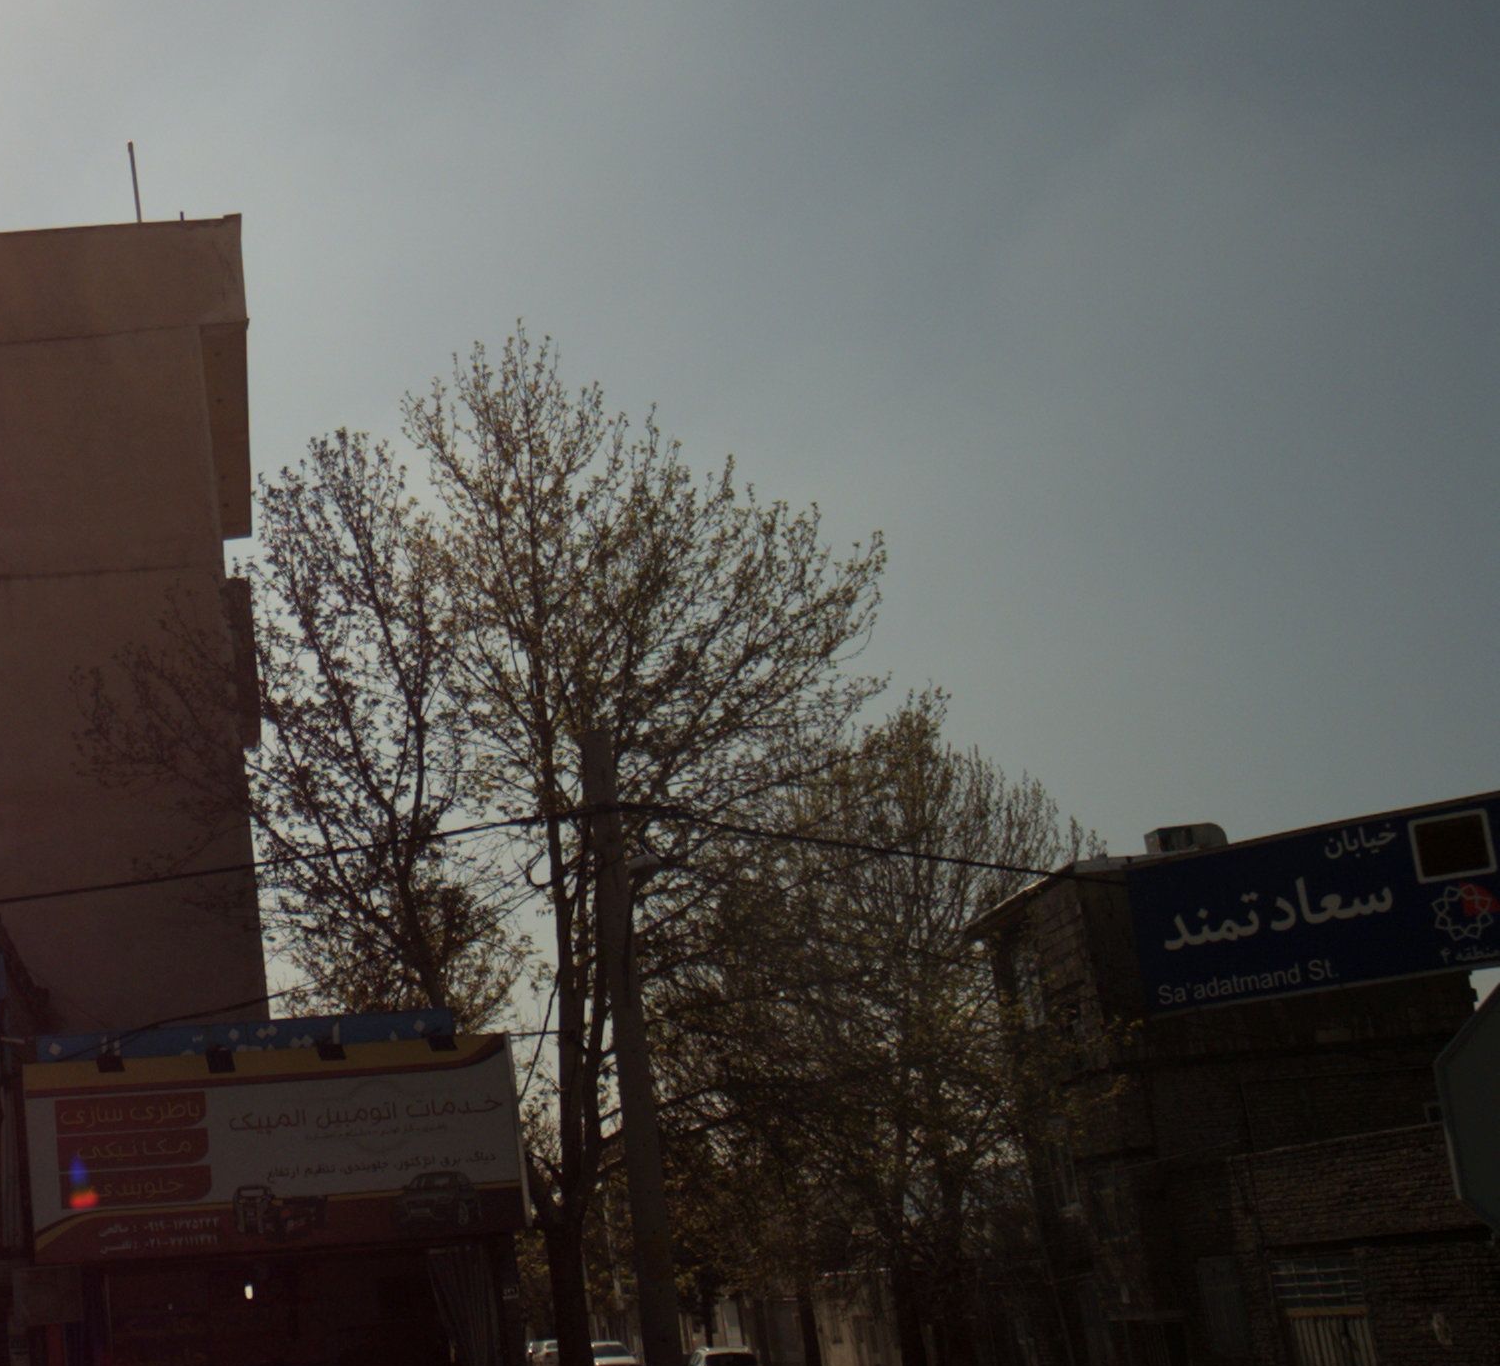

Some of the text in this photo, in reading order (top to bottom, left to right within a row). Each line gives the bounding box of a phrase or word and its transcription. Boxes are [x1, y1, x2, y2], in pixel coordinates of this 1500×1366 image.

[1323, 822, 1397, 860] خیابان
[1163, 876, 1394, 952] سعادتمند
[1157, 958, 1340, 1006] Sa'adatmand St.
[60, 1100, 201, 1129] باطری سازی
[315, 1101, 397, 1129] اتومبیل
[405, 1095, 503, 1119] خدمات
[228, 1110, 308, 1135] المپیک
[76, 1137, 193, 1162] مکانیکی
